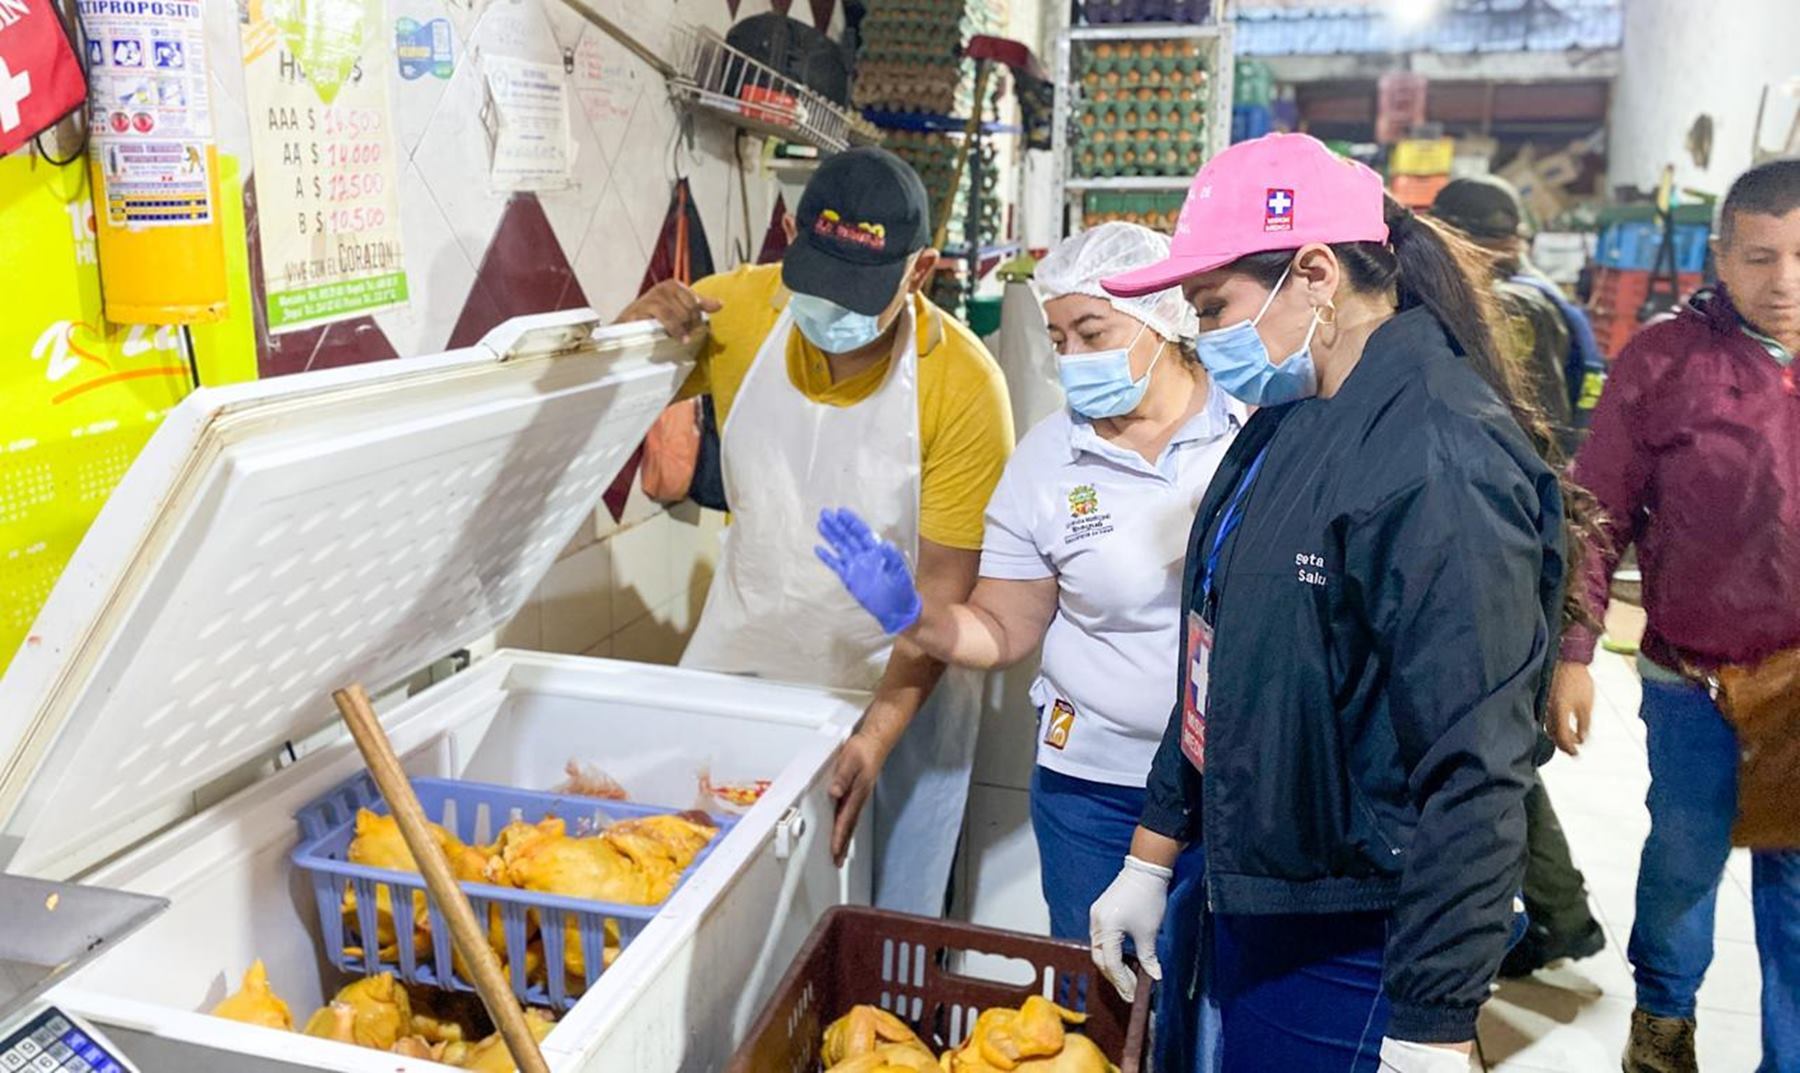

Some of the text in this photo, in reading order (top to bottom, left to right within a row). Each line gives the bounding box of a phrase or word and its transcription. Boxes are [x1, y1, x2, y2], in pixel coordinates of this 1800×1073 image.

[268, 107, 299, 131] AAA
[283, 142, 303, 166] AA
[296, 176, 304, 198] A
[298, 211, 307, 235] B
